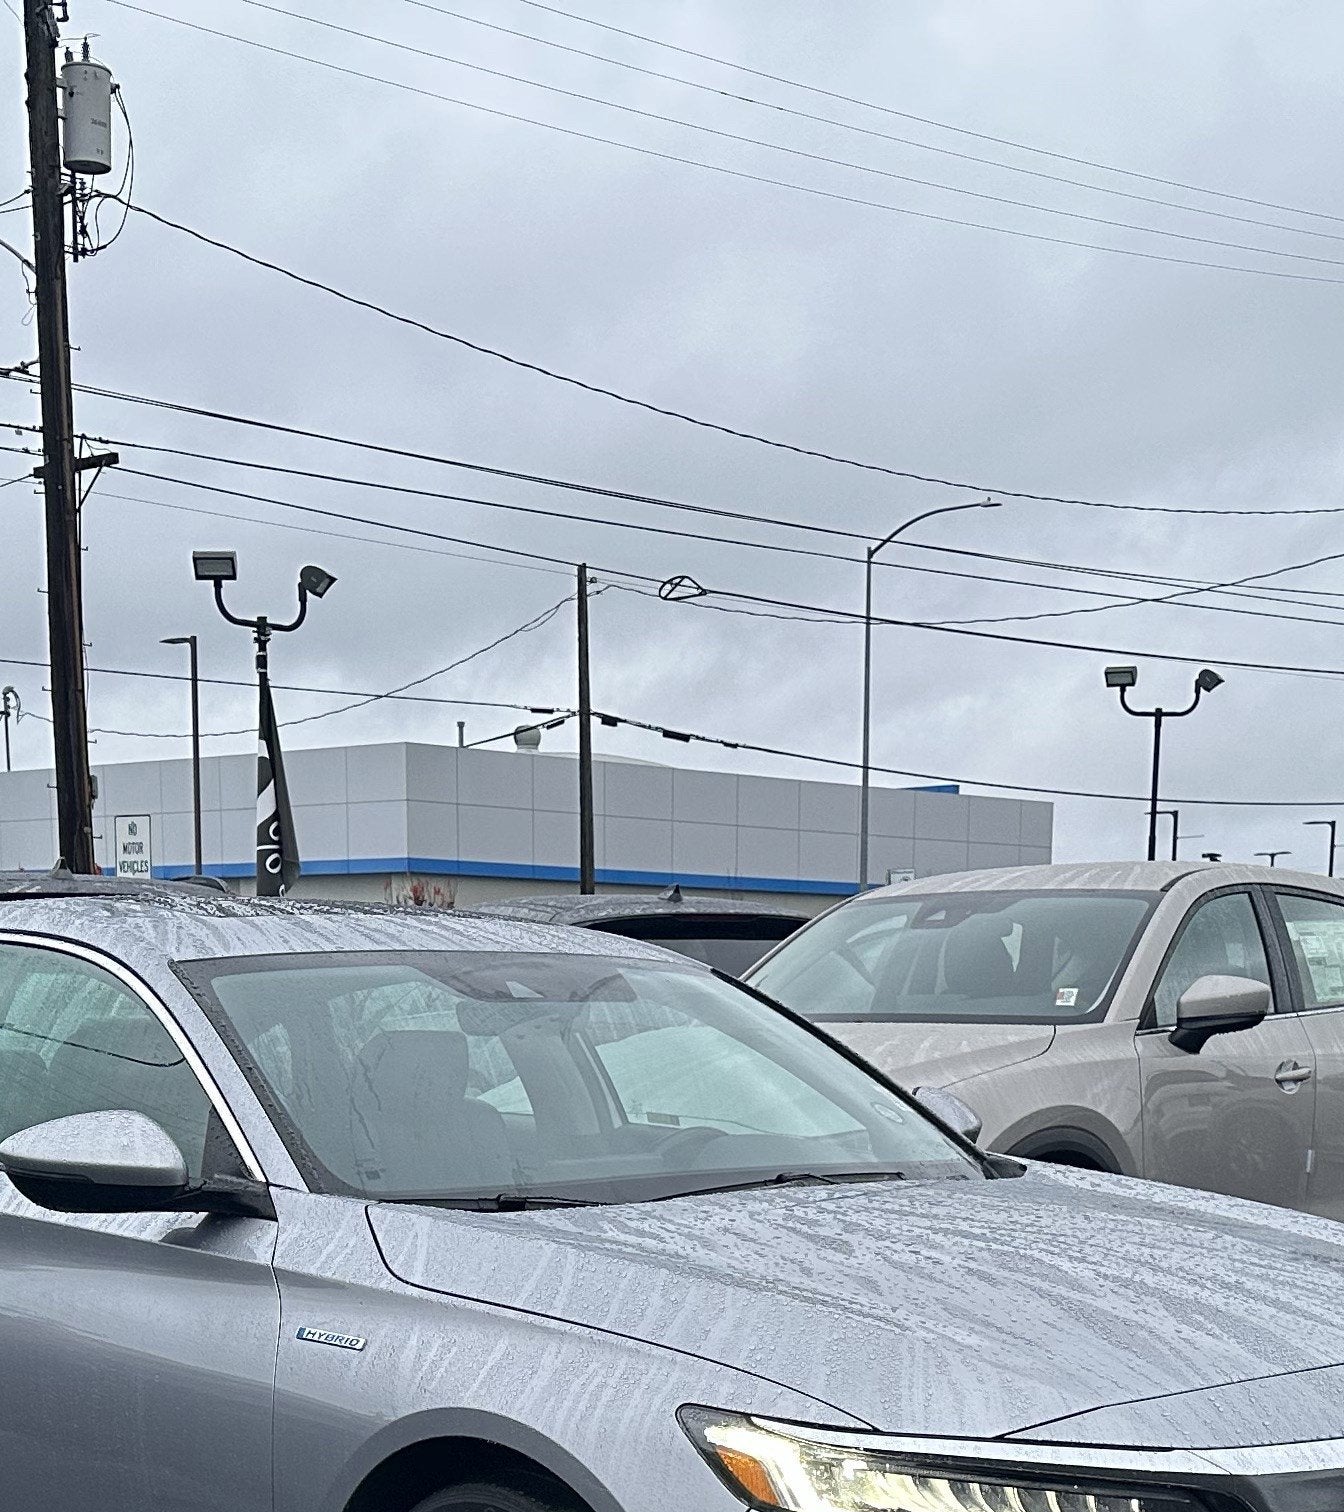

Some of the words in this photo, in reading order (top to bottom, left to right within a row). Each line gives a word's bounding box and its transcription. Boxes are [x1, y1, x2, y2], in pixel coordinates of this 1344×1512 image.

[128, 821, 137, 836] NO
[123, 842, 144, 855] MOTOR
[119, 860, 149, 874] VEHICLES
[306, 1329, 361, 1347] HYBRID
